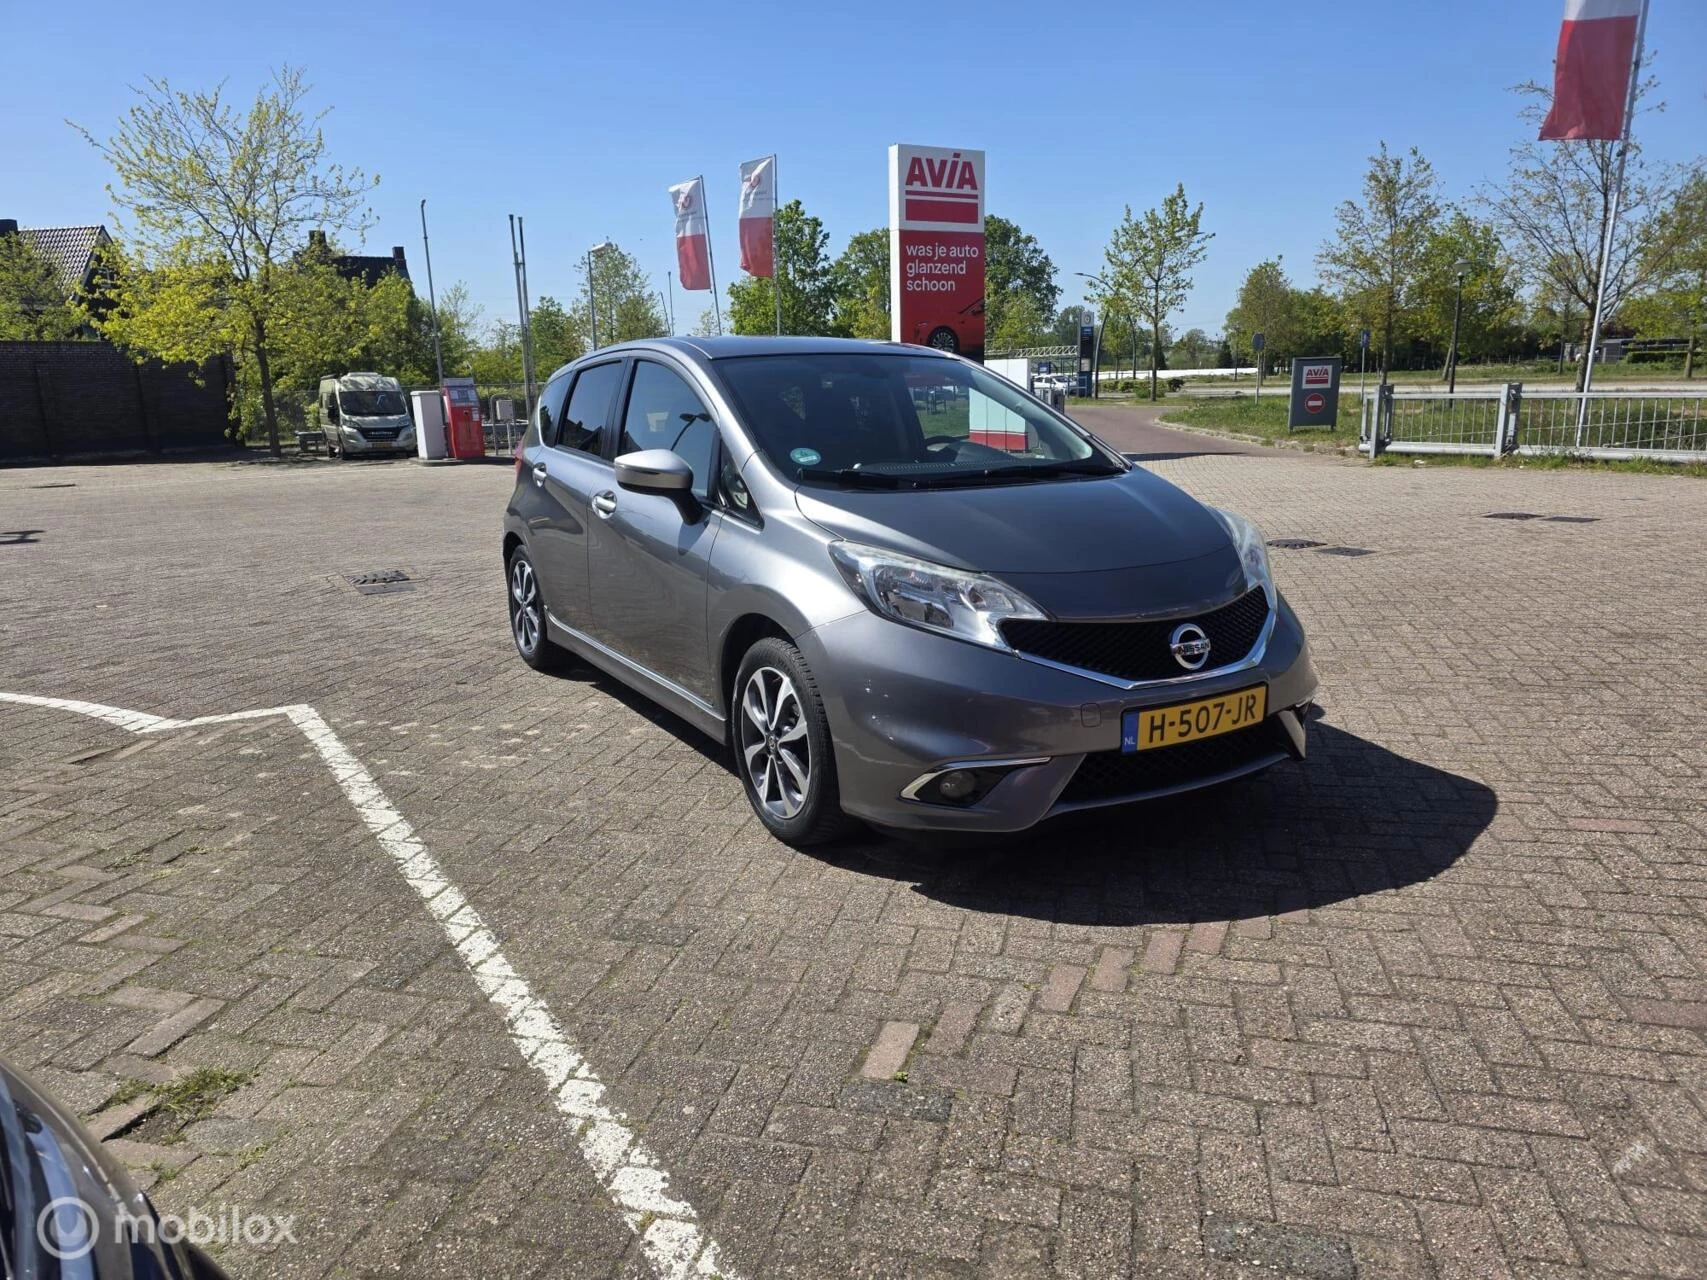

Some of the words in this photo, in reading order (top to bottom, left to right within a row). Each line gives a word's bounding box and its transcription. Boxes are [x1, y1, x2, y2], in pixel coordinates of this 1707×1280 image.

[905, 152, 978, 190] AVIA
[906, 244, 933, 257] was
[935, 242, 947, 261] je
[949, 244, 979, 258] auto
[906, 260, 967, 277] glanzend
[906, 276, 956, 292] schoon
[1306, 366, 1329, 377] AVIA
[1124, 736, 1136, 745] NL
[1149, 693, 1257, 743] H-507-JR
